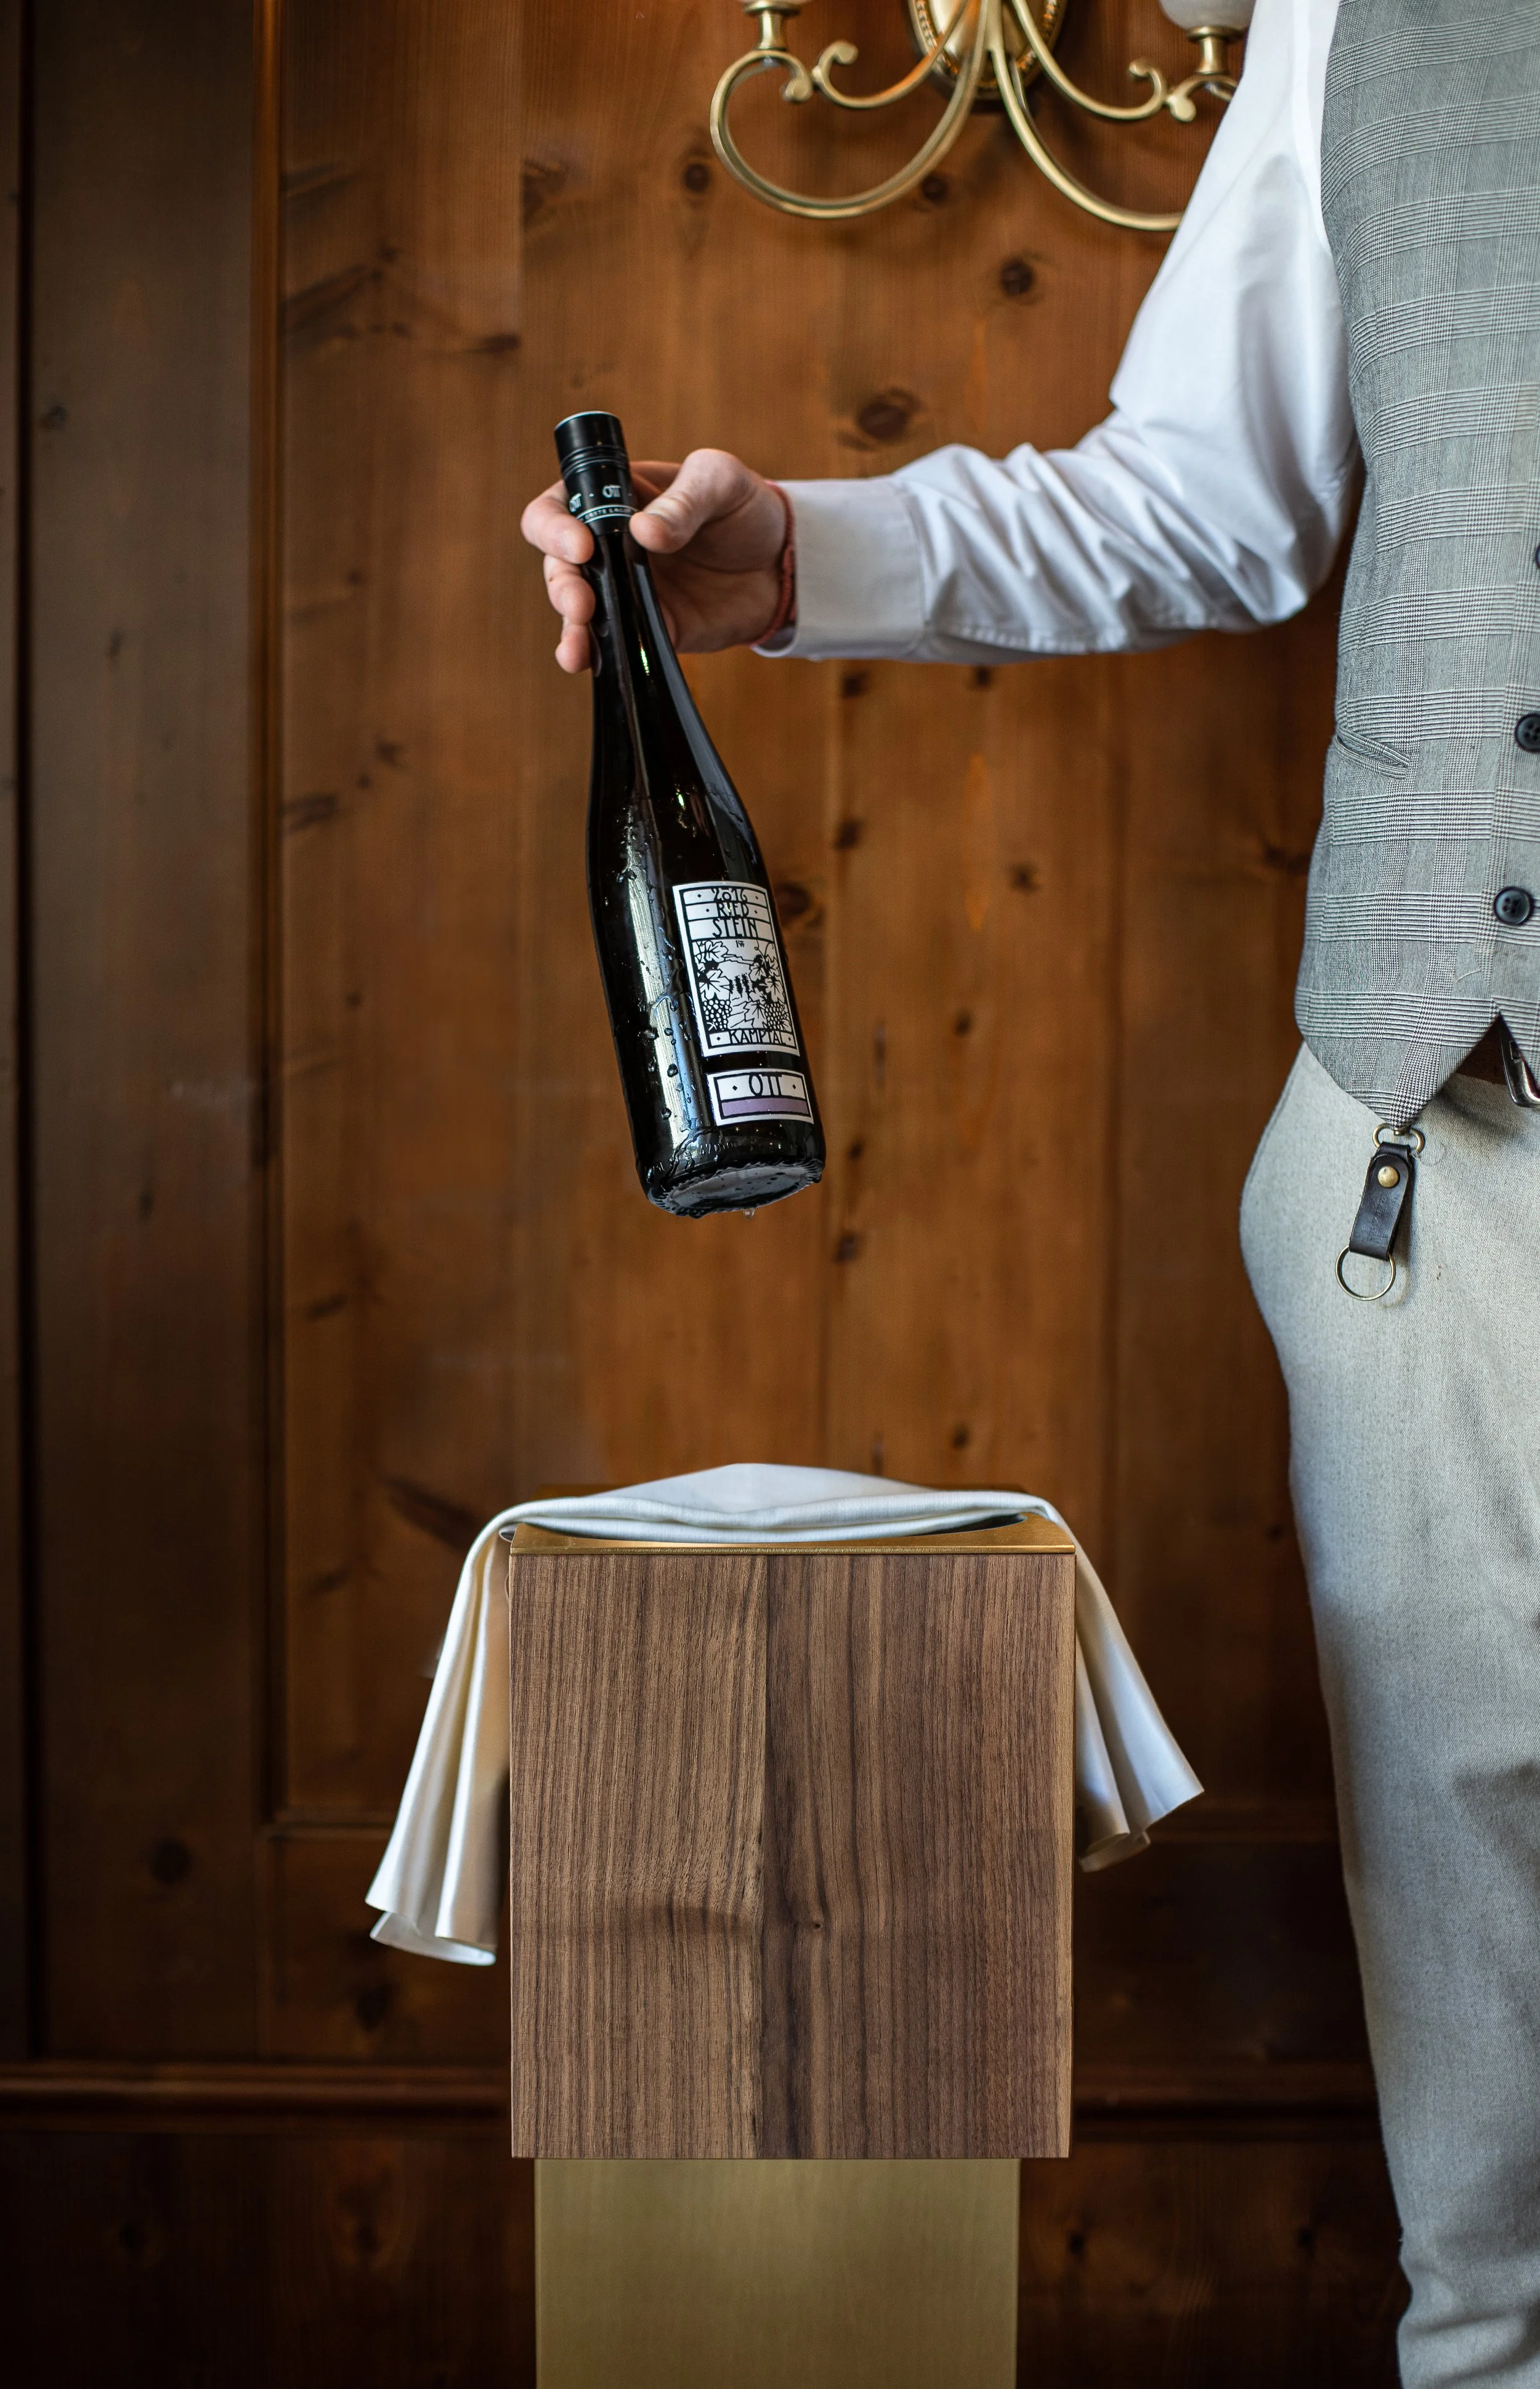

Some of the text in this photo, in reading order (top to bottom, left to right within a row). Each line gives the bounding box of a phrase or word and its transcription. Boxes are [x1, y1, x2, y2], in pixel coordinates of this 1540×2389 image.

[602, 485, 621, 498] OTT
[711, 887, 748, 903] 2016
[716, 902, 749, 918] RIED
[712, 918, 759, 938] STEIN
[729, 1029, 787, 1045] KAMPTAL
[748, 1072, 782, 1097] OTT
